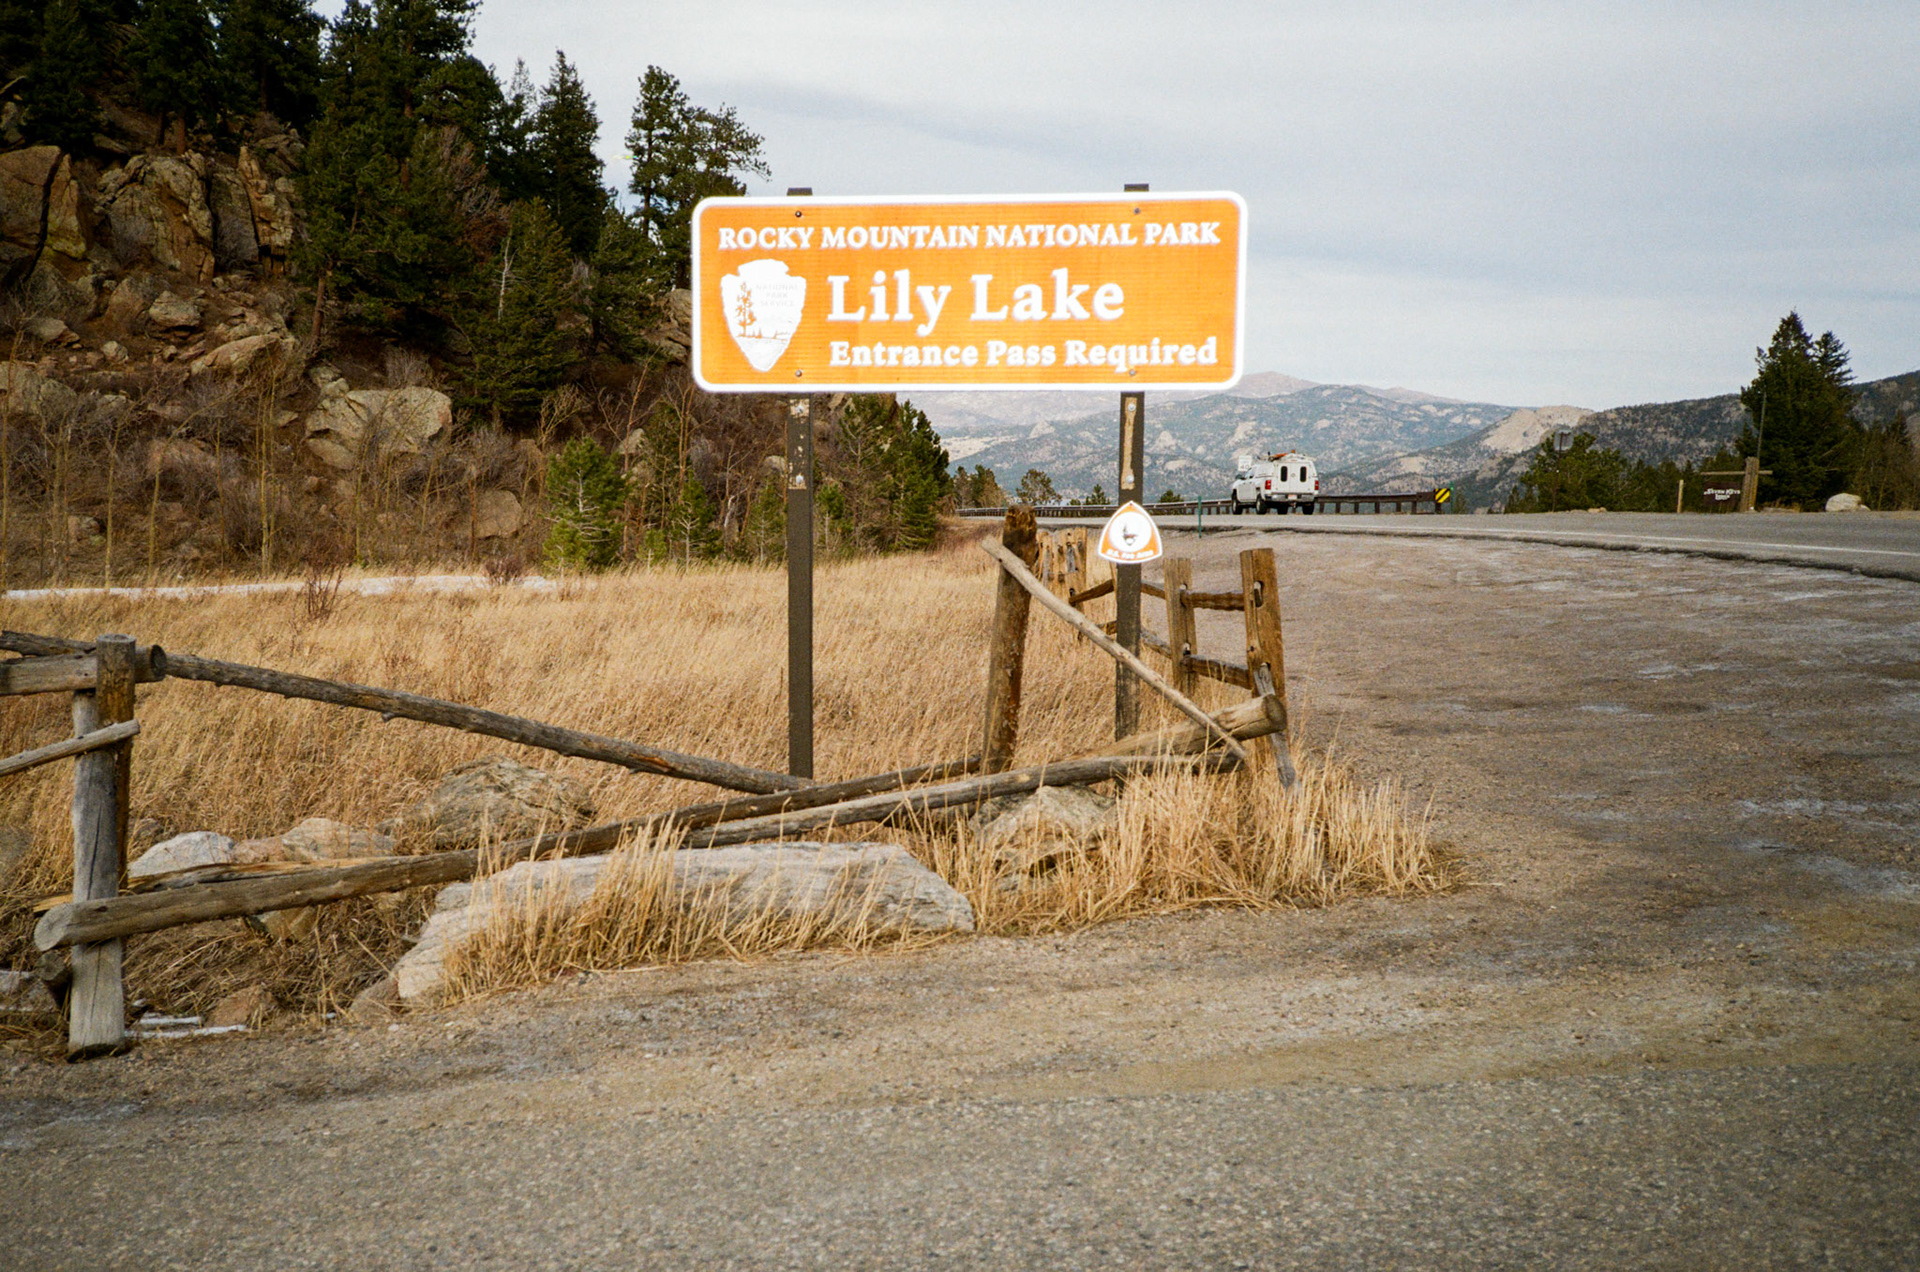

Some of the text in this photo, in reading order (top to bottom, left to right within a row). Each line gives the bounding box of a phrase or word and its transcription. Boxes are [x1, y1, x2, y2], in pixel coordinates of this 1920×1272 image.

[719, 222, 1221, 249] ROCKY MOUNTAIN NATIONAL PARK
[827, 267, 1124, 337] Lily Lake
[829, 336, 1217, 373] Entrance Pass Required
